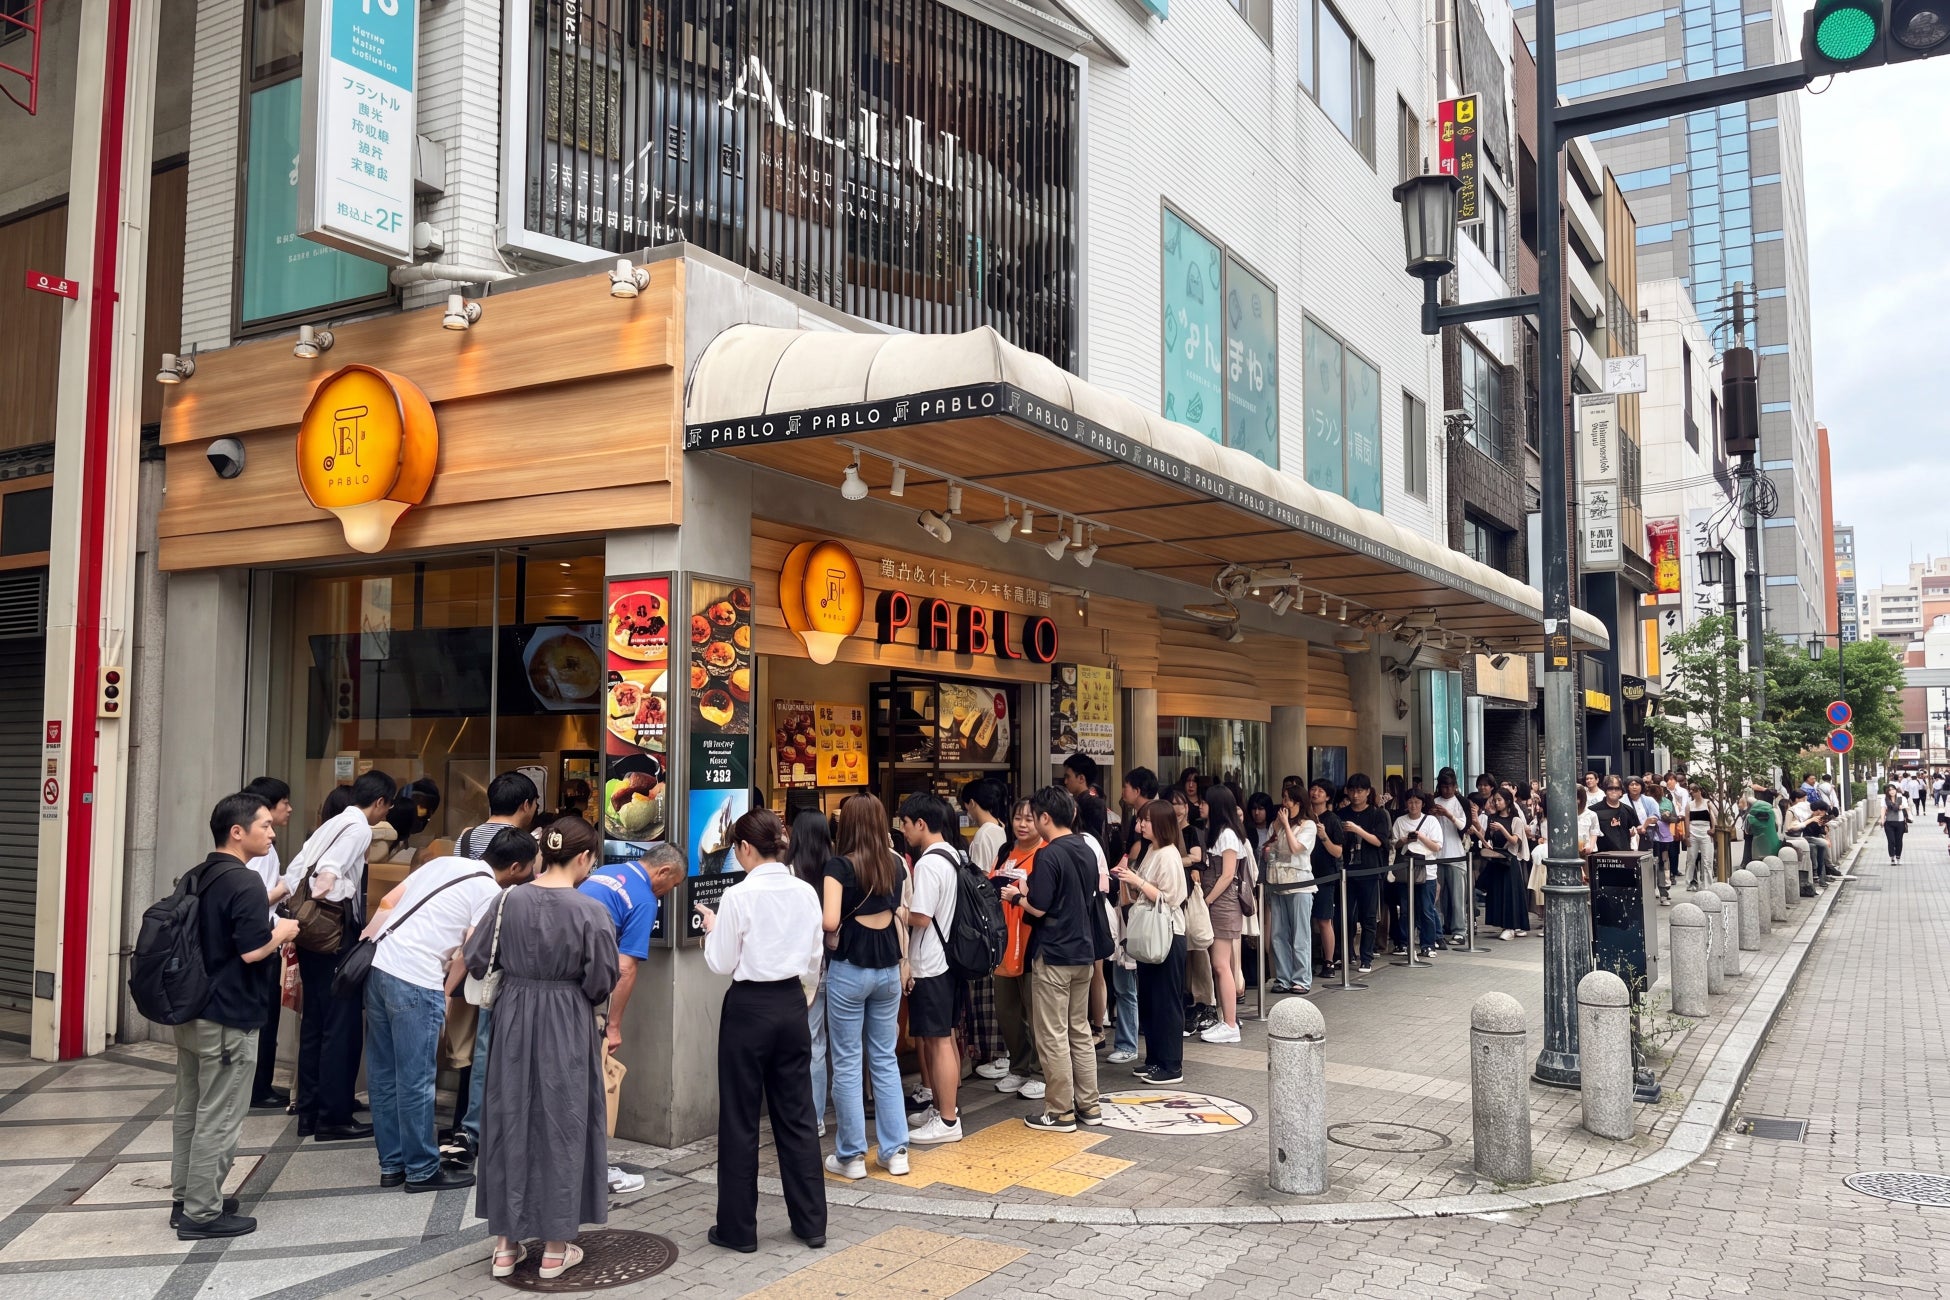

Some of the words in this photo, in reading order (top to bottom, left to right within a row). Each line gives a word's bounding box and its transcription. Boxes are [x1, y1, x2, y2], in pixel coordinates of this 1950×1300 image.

[711, 421, 774, 443] PABLO
[812, 408, 880, 431] PABLO
[920, 392, 995, 417] PABLO
[328, 474, 370, 488] PABLO
[1027, 401, 1069, 433] PABLO
[1090, 430, 1127, 457] PABLO
[1146, 453, 1179, 478] PABLO
[1195, 472, 1224, 496] PABLO
[1239, 491, 1265, 512] PABLO
[1277, 506, 1301, 527] PABLO
[877, 590, 1058, 664] PABLO
